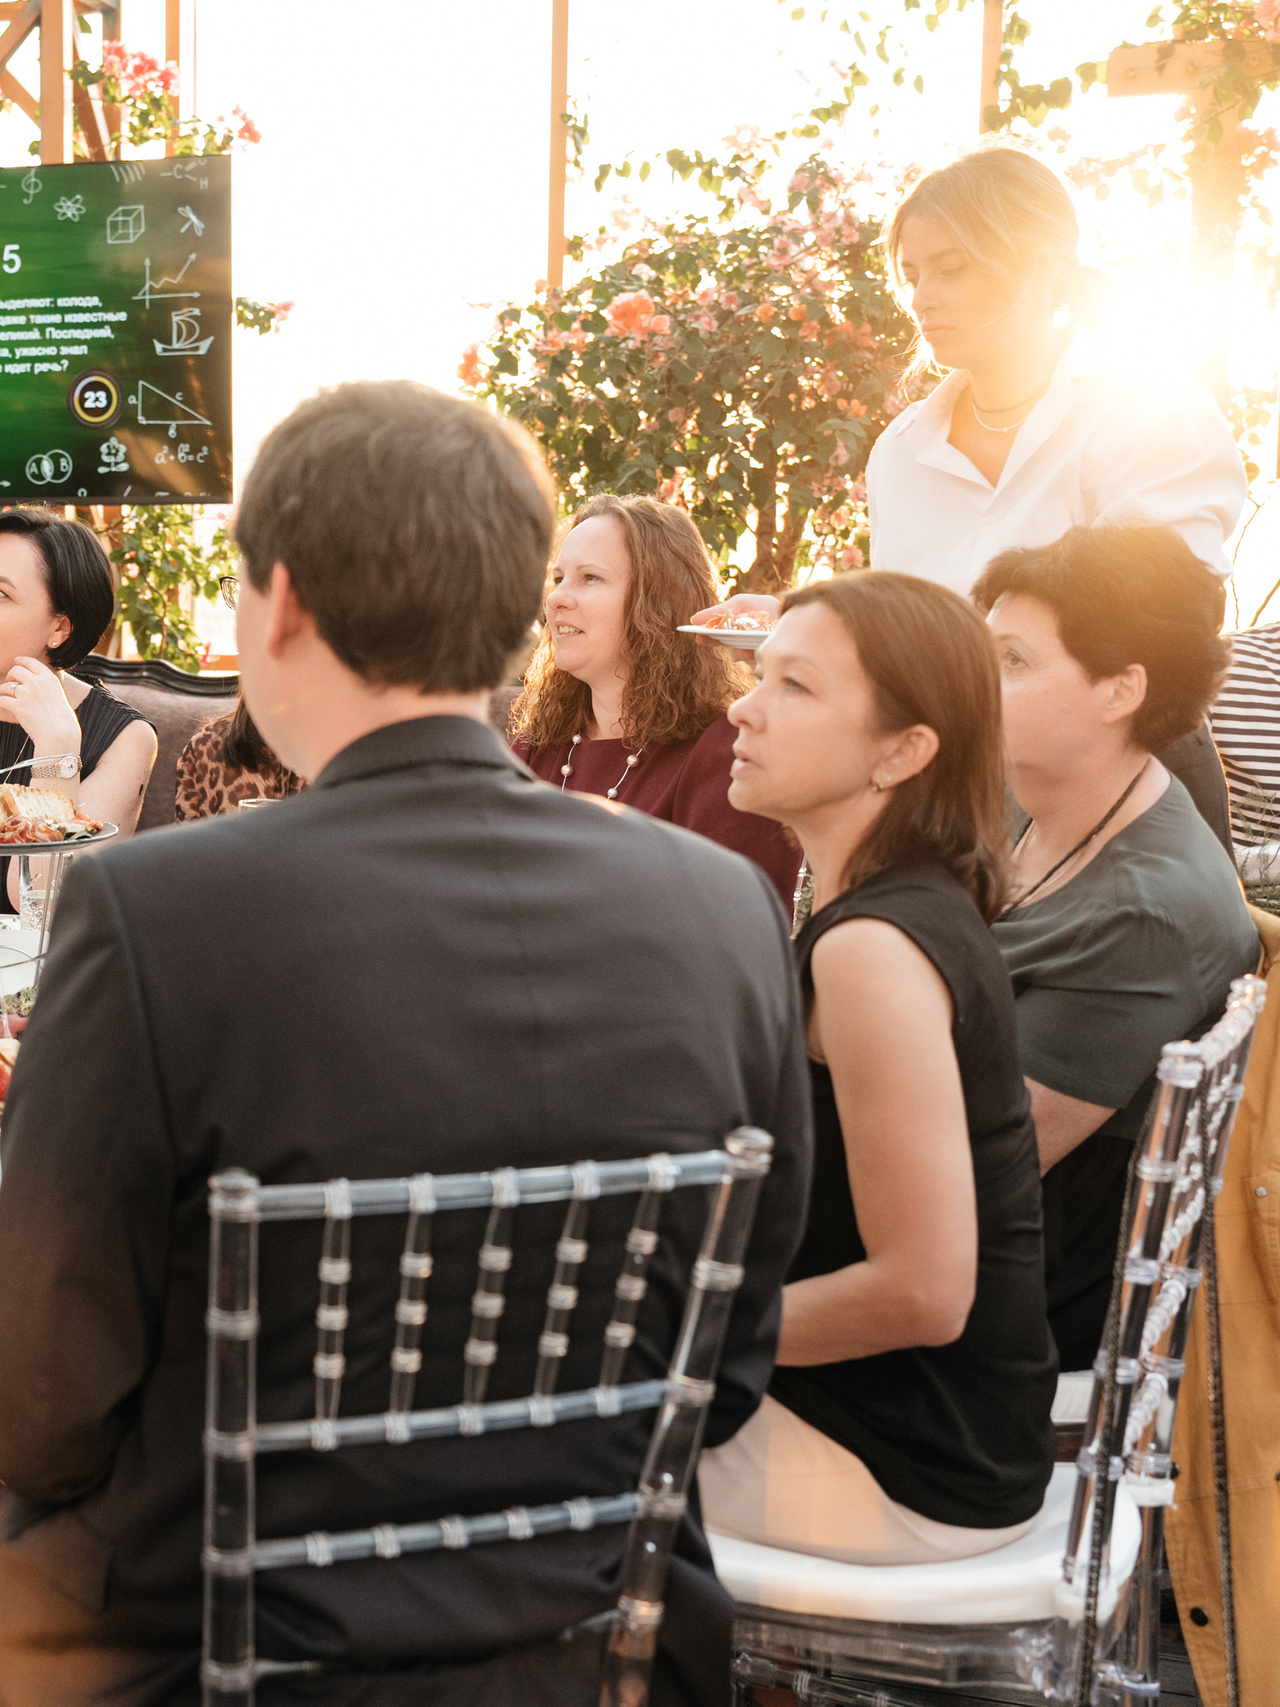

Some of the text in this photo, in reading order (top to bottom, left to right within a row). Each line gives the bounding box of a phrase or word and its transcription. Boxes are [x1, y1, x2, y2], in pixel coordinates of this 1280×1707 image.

[2, 244, 22, 274] 5
[57, 296, 103, 308] колода,
[29, 314, 62, 324] такие
[64, 311, 128, 323] известные
[45, 325, 115, 340] Последний,
[14, 345, 57, 359] ужасно
[59, 344, 89, 356] знал
[4, 363, 32, 375] идет
[34, 359, 69, 375] речь?
[83, 390, 108, 409] 23
